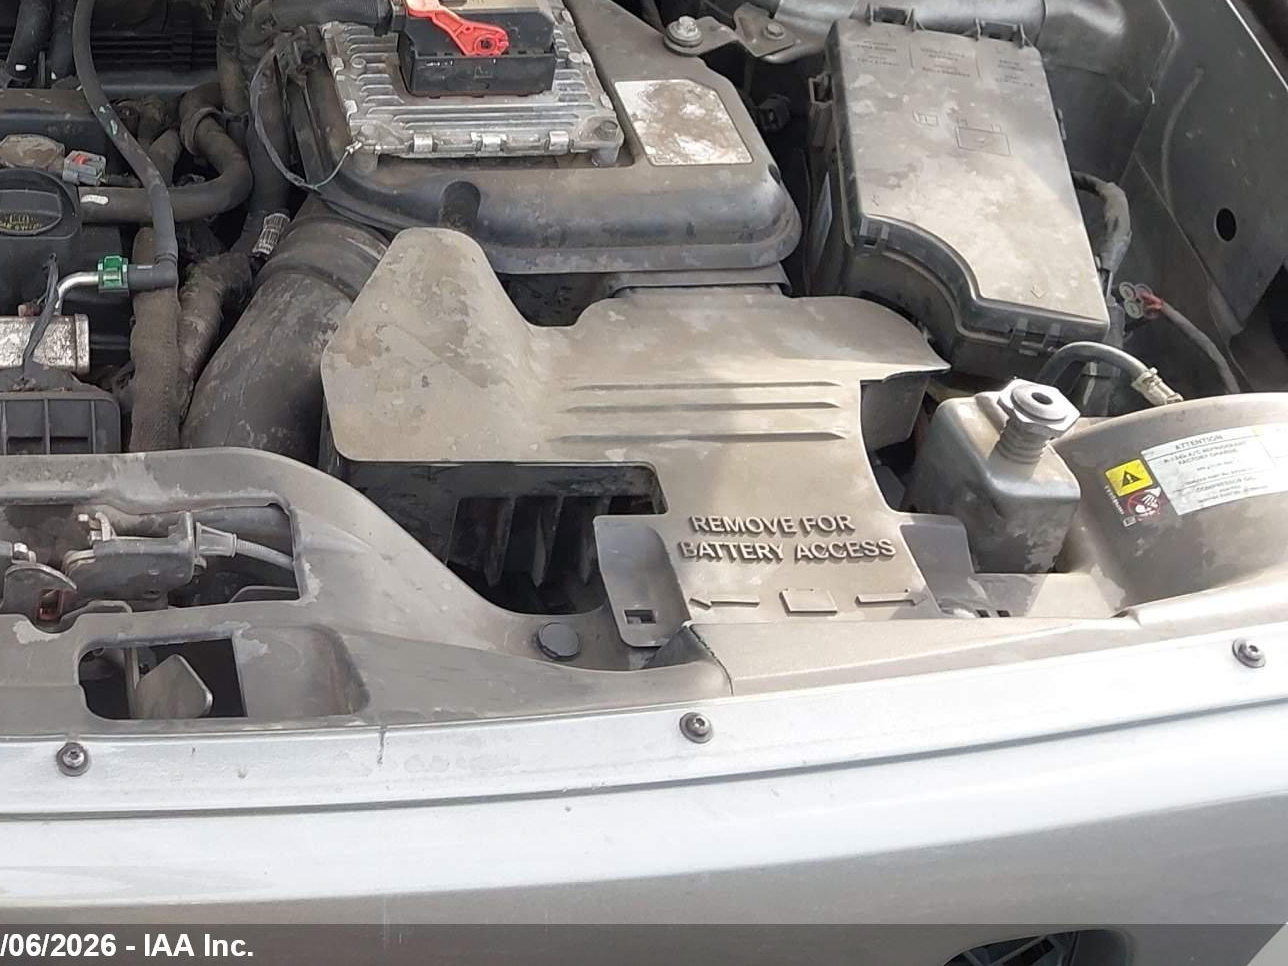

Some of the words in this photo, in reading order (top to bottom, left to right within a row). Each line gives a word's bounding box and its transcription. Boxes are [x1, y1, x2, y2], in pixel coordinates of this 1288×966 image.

[1175, 434, 1224, 450] ATTENTION
[689, 515, 797, 535] REMOVE
[801, 514, 856, 535] FOR
[679, 540, 785, 563] BATTERY
[795, 539, 897, 561] ACCESS
